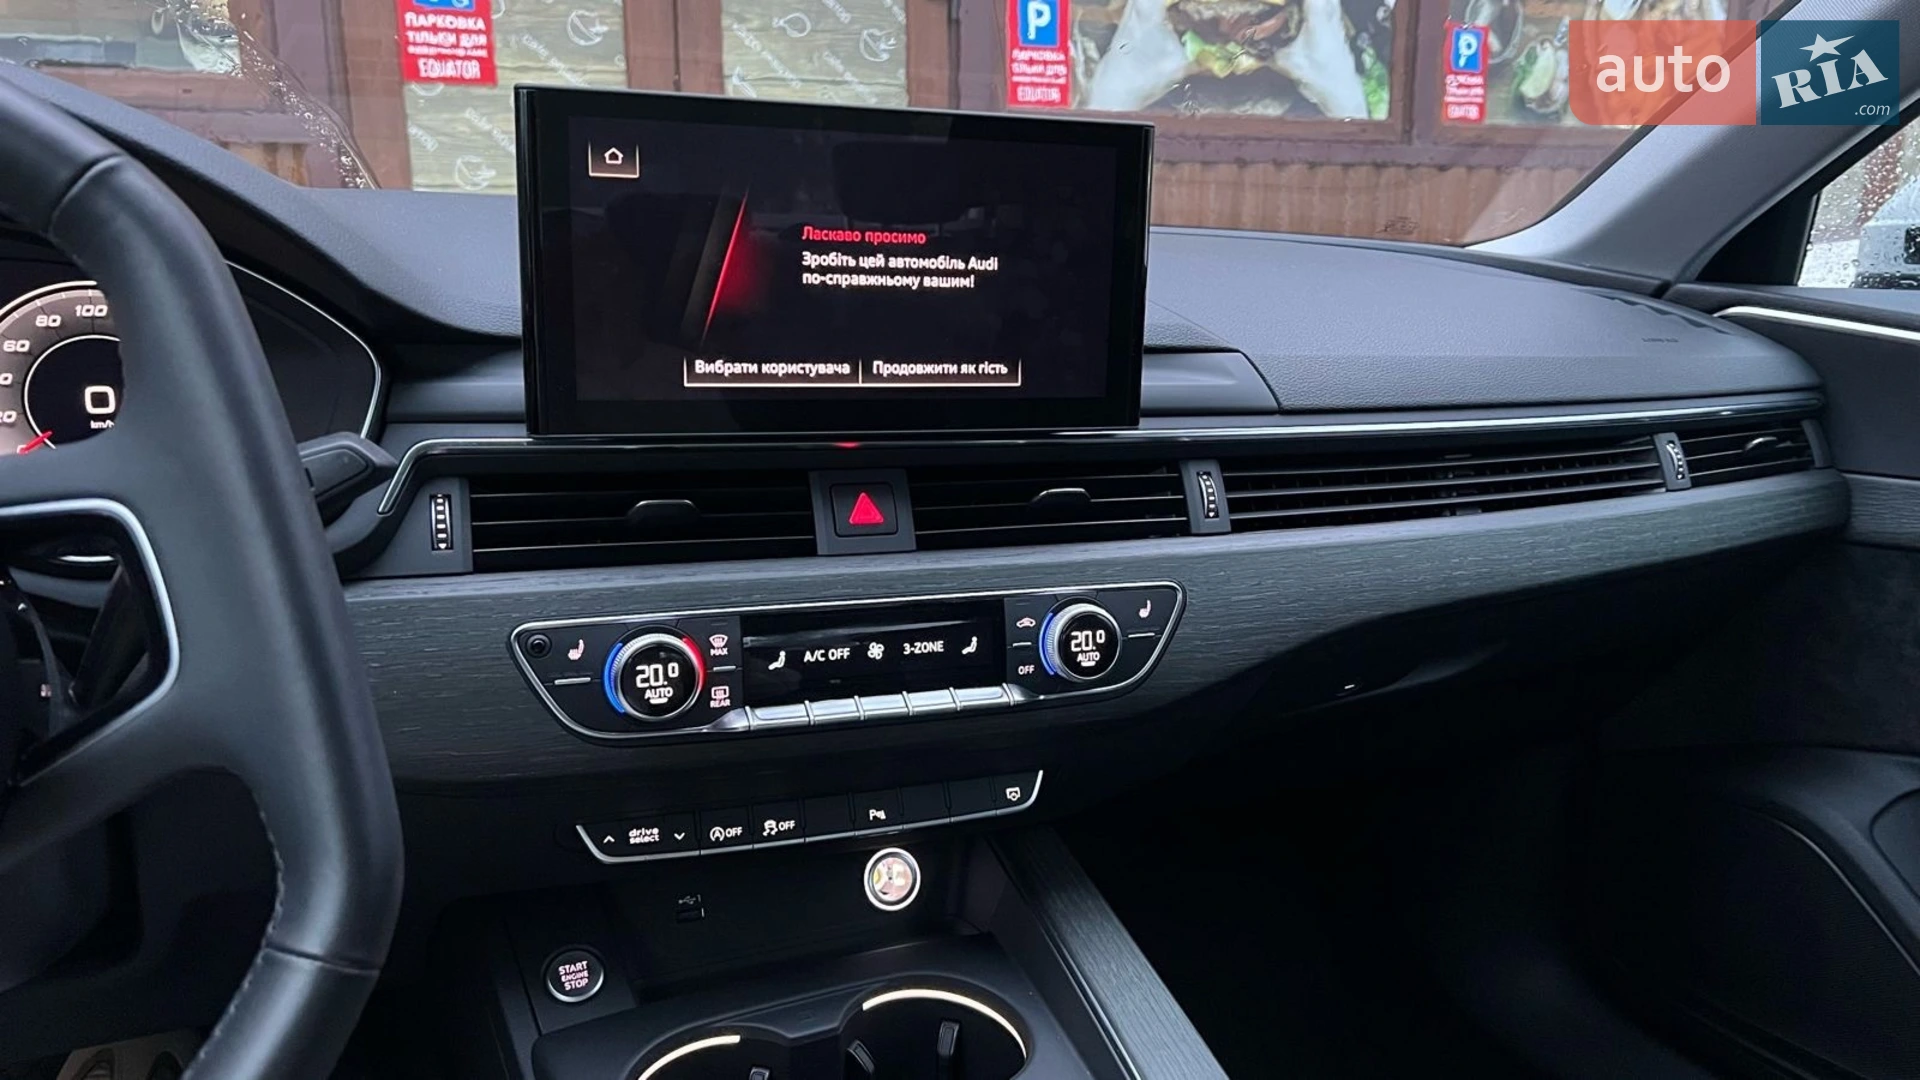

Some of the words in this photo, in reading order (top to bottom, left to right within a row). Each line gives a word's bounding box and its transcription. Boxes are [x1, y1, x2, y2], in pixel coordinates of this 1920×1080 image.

[404, 11, 486, 31] ПАРКОВКА
[1027, 0, 1052, 41] P
[405, 30, 457, 47] ТІЛЬКИ
[459, 32, 488, 48] ДЛЯ
[1458, 32, 1478, 68] P
[801, 225, 862, 242] Ласкаво
[864, 230, 928, 246] просимо
[801, 251, 857, 269] Зробіть
[858, 253, 886, 270] цей
[887, 255, 966, 271] автомобіль
[967, 256, 999, 271] Audi
[802, 272, 921, 290] по-справжньому
[922, 275, 975, 289] вашим!
[75, 304, 108, 317] 100
[35, 314, 62, 327] 80
[3, 339, 30, 352] 60
[694, 359, 759, 378] Вибрати
[761, 362, 851, 378] користувача
[872, 360, 958, 379] Продовжити
[960, 363, 977, 375] як
[978, 360, 1009, 376] гість
[84, 385, 116, 415] 0
[710, 647, 729, 657] MAX
[803, 649, 826, 662] A/C
[828, 647, 851, 661] OFF
[903, 640, 945, 655] 3-ZONE
[1076, 651, 1100, 663] AUTO
[1017, 664, 1035, 676] OFF
[644, 686, 674, 700] AUTO
[709, 698, 731, 708] REAR
[628, 827, 660, 838] drive
[725, 826, 743, 838] OFF
[778, 820, 796, 832] OFF
[629, 836, 660, 845] select
[558, 960, 588, 976] START
[561, 970, 588, 982] ENGINE
[564, 977, 589, 991] STOP
